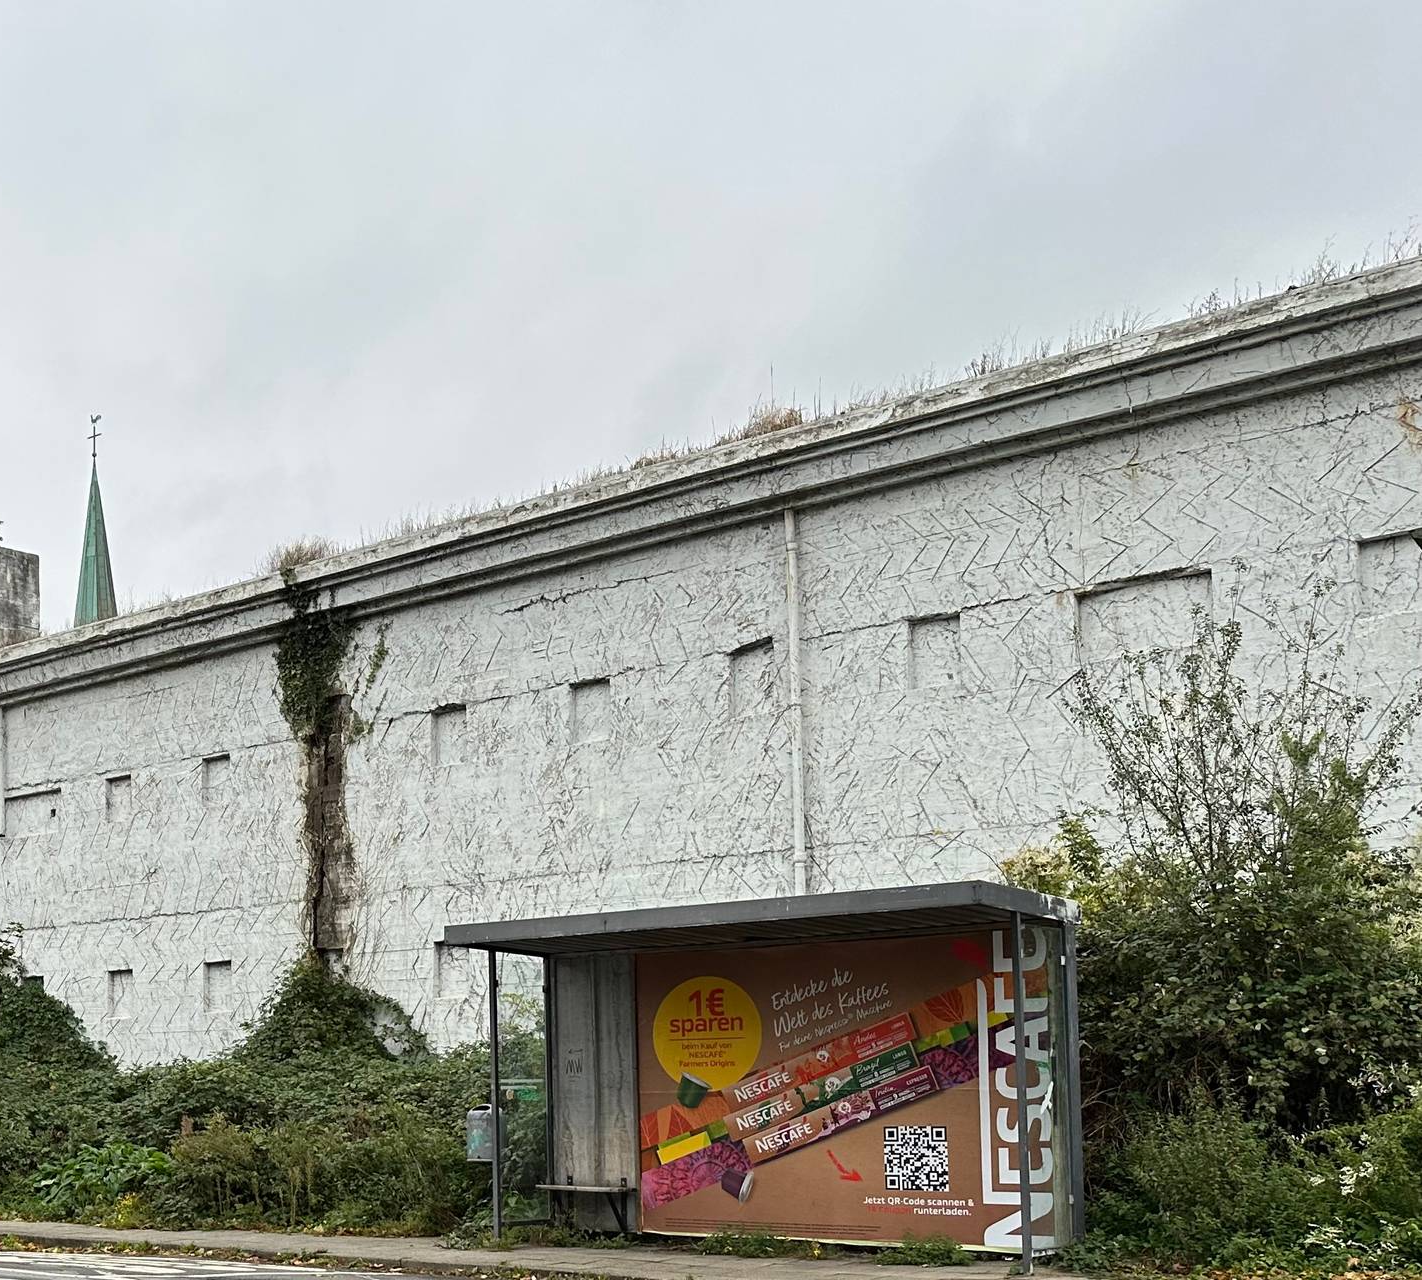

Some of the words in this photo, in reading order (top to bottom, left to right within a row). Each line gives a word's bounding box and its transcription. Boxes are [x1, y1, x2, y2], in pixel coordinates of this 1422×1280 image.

[771, 979, 828, 1011] Entdecke
[831, 967, 854, 988] die
[688, 987, 725, 1017] 1€
[773, 1008, 809, 1037] Welt
[812, 1001, 834, 1020] des
[838, 982, 889, 1015] Kaffees
[669, 1016, 744, 1037] sparen
[863, 1196, 885, 1204] Jetzt
[887, 1197, 925, 1206] QR-Code
[927, 1198, 966, 1207] scannen
[967, 1199, 974, 1207] &
[913, 1207, 972, 1216] runterladen.
